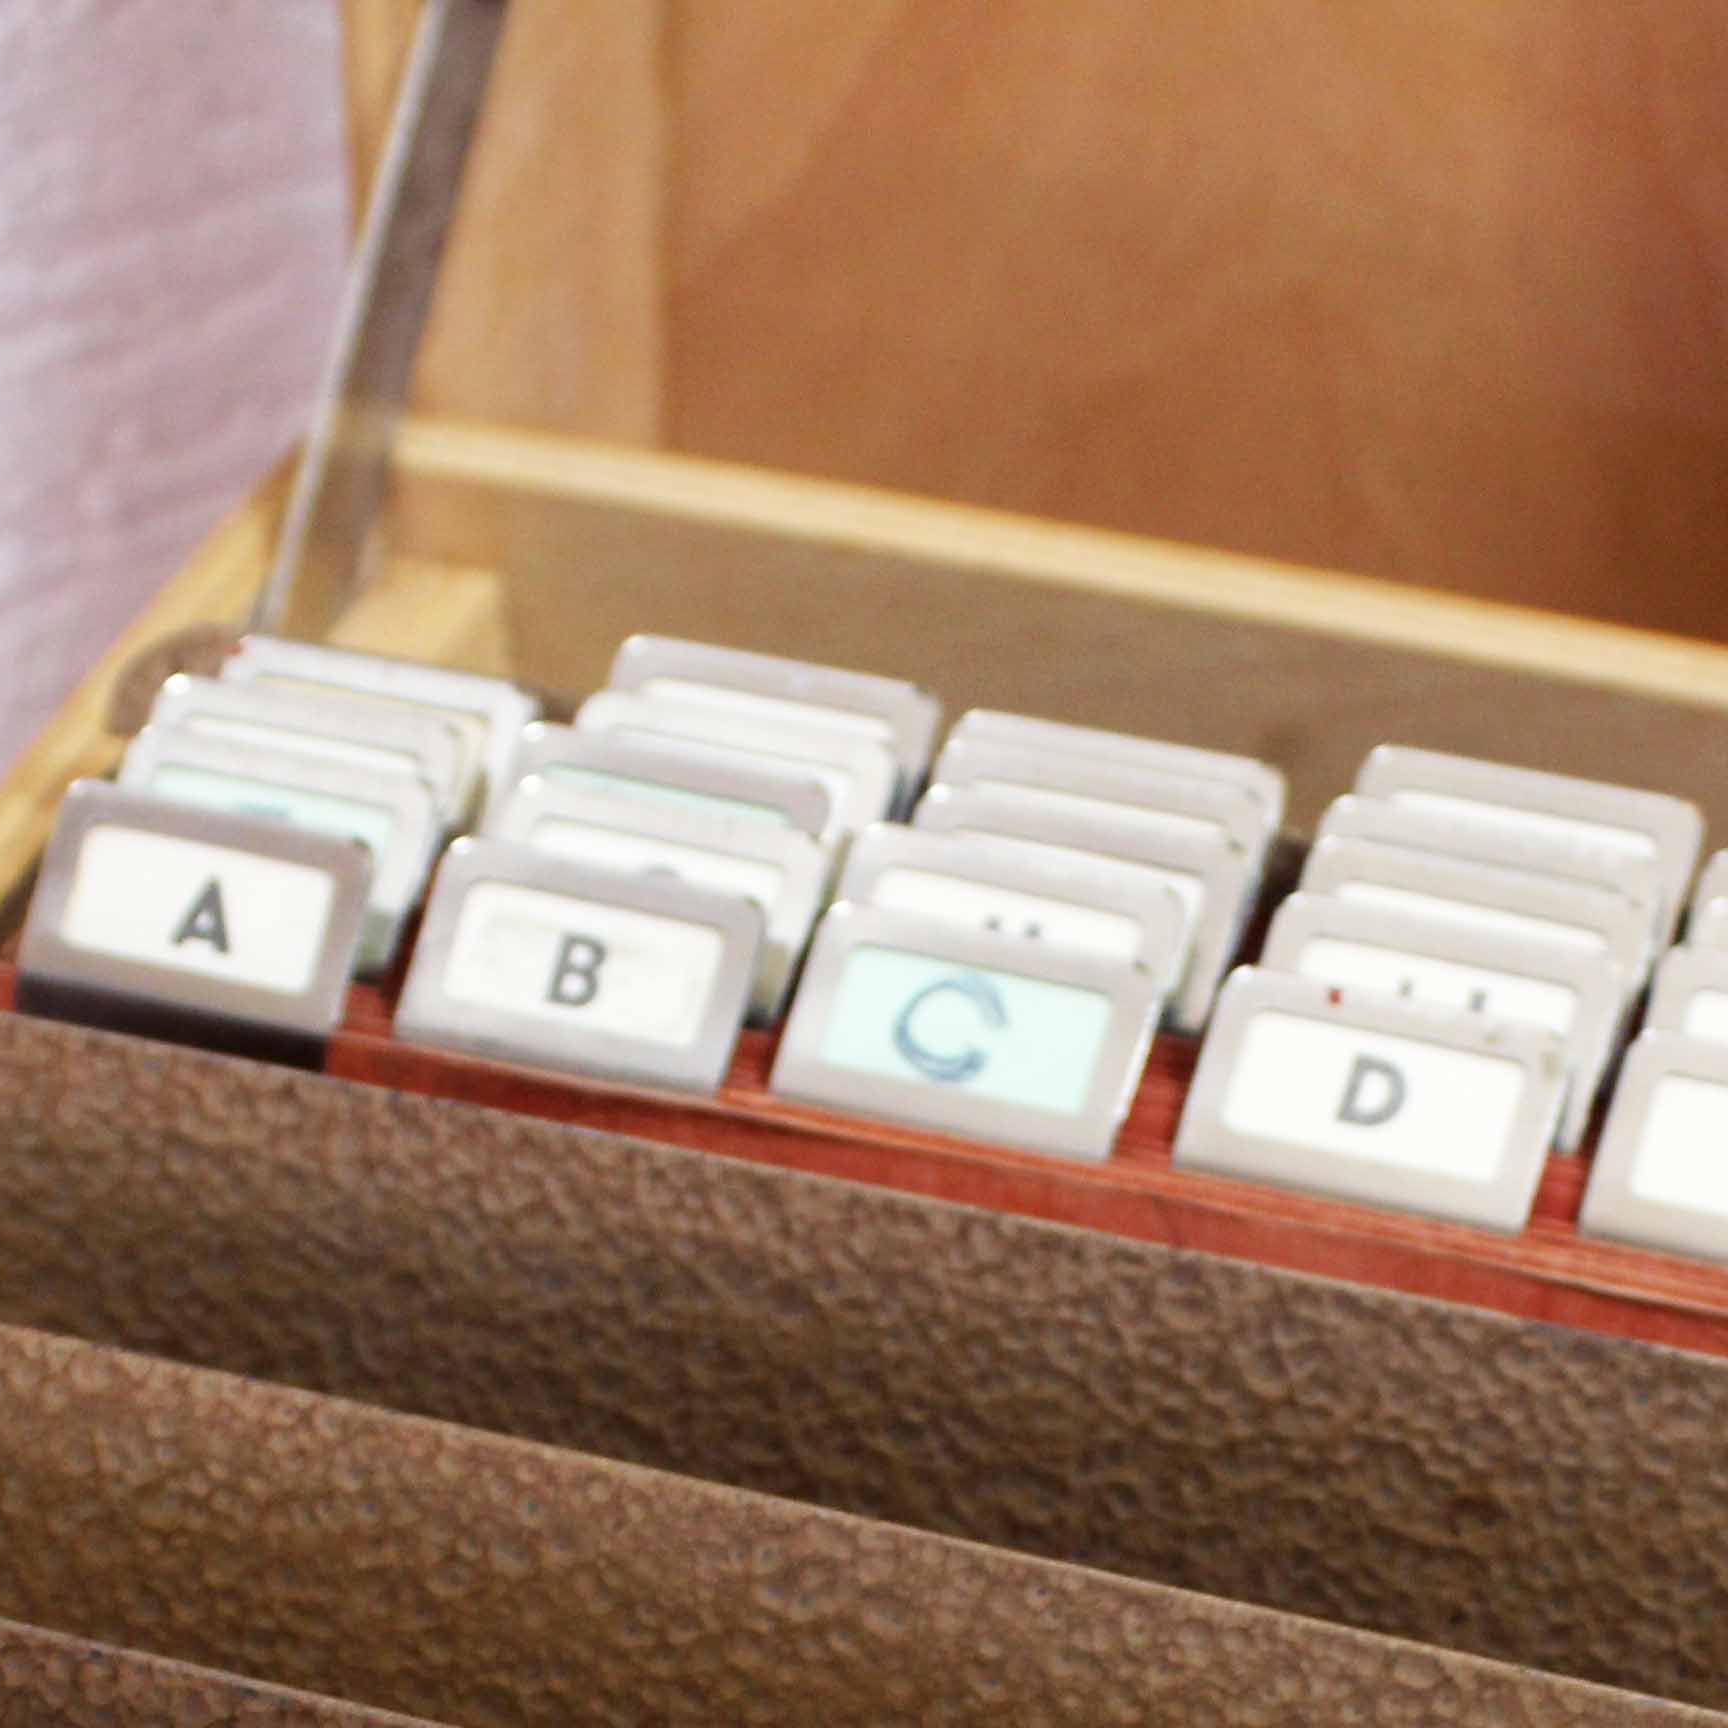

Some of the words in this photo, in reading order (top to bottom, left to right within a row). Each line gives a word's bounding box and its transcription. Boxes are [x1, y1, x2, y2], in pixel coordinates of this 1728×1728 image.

[173, 877, 231, 955] A
[546, 933, 606, 1007] B
[893, 971, 1009, 1083] C
[1336, 1054, 1406, 1126] D
